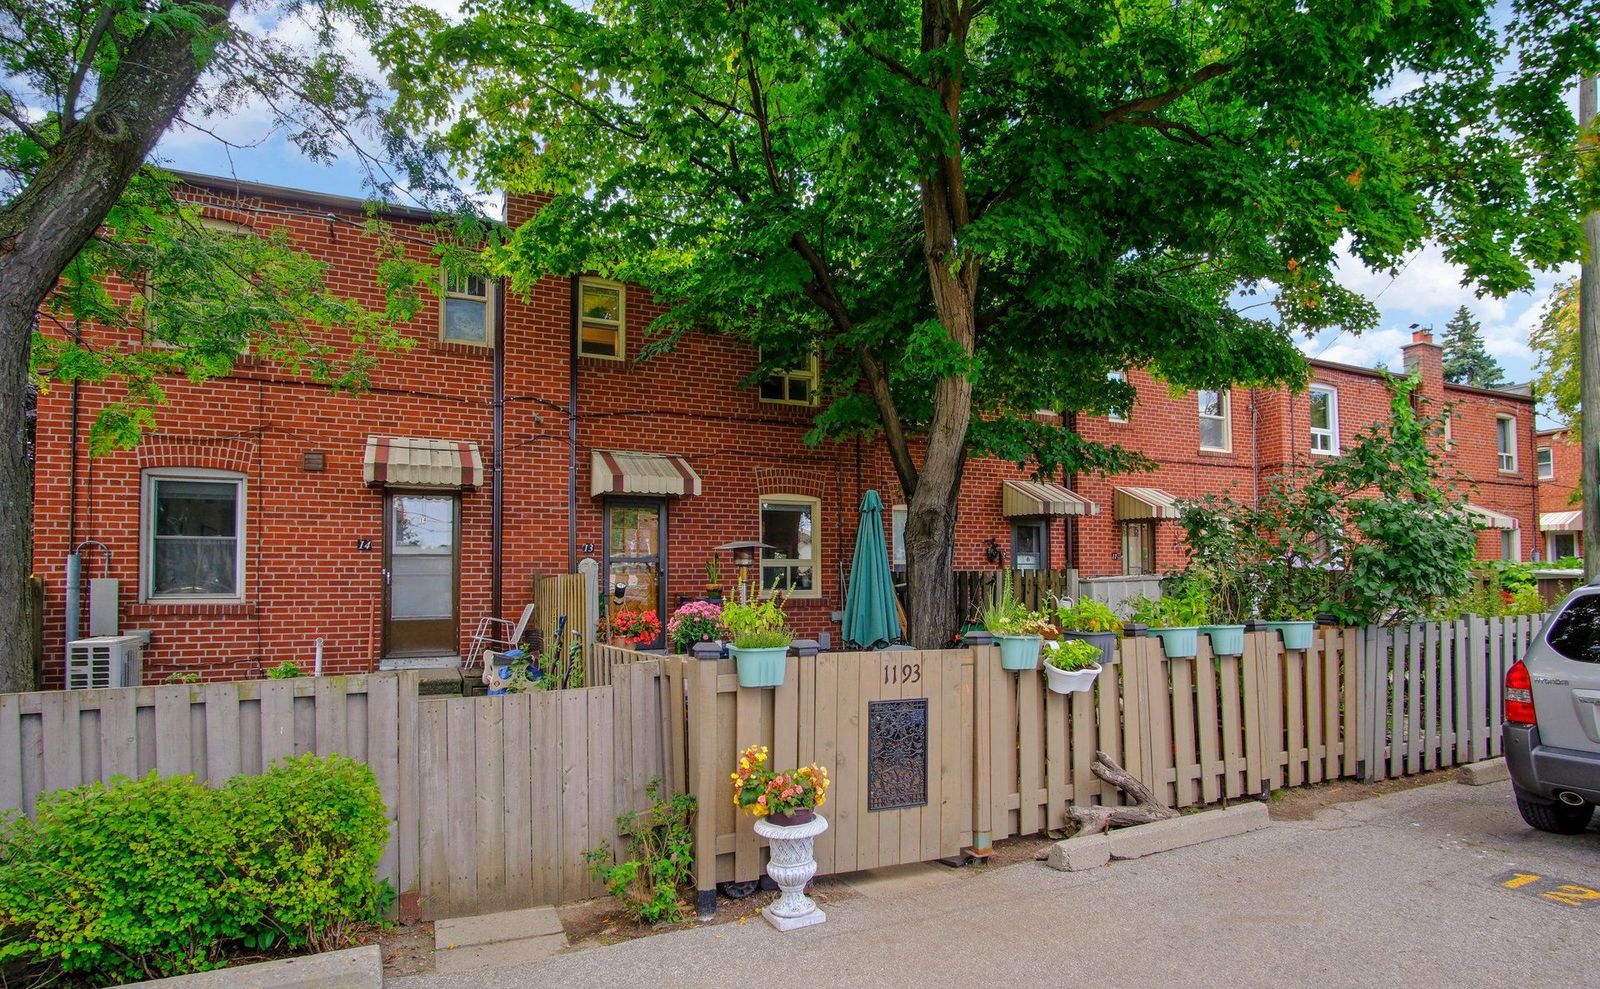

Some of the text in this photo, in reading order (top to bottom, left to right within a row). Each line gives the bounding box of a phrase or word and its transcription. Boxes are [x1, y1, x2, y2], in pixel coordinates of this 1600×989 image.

[359, 540, 371, 549] 14
[584, 543, 594, 552] 13
[884, 663, 921, 685] 1193
